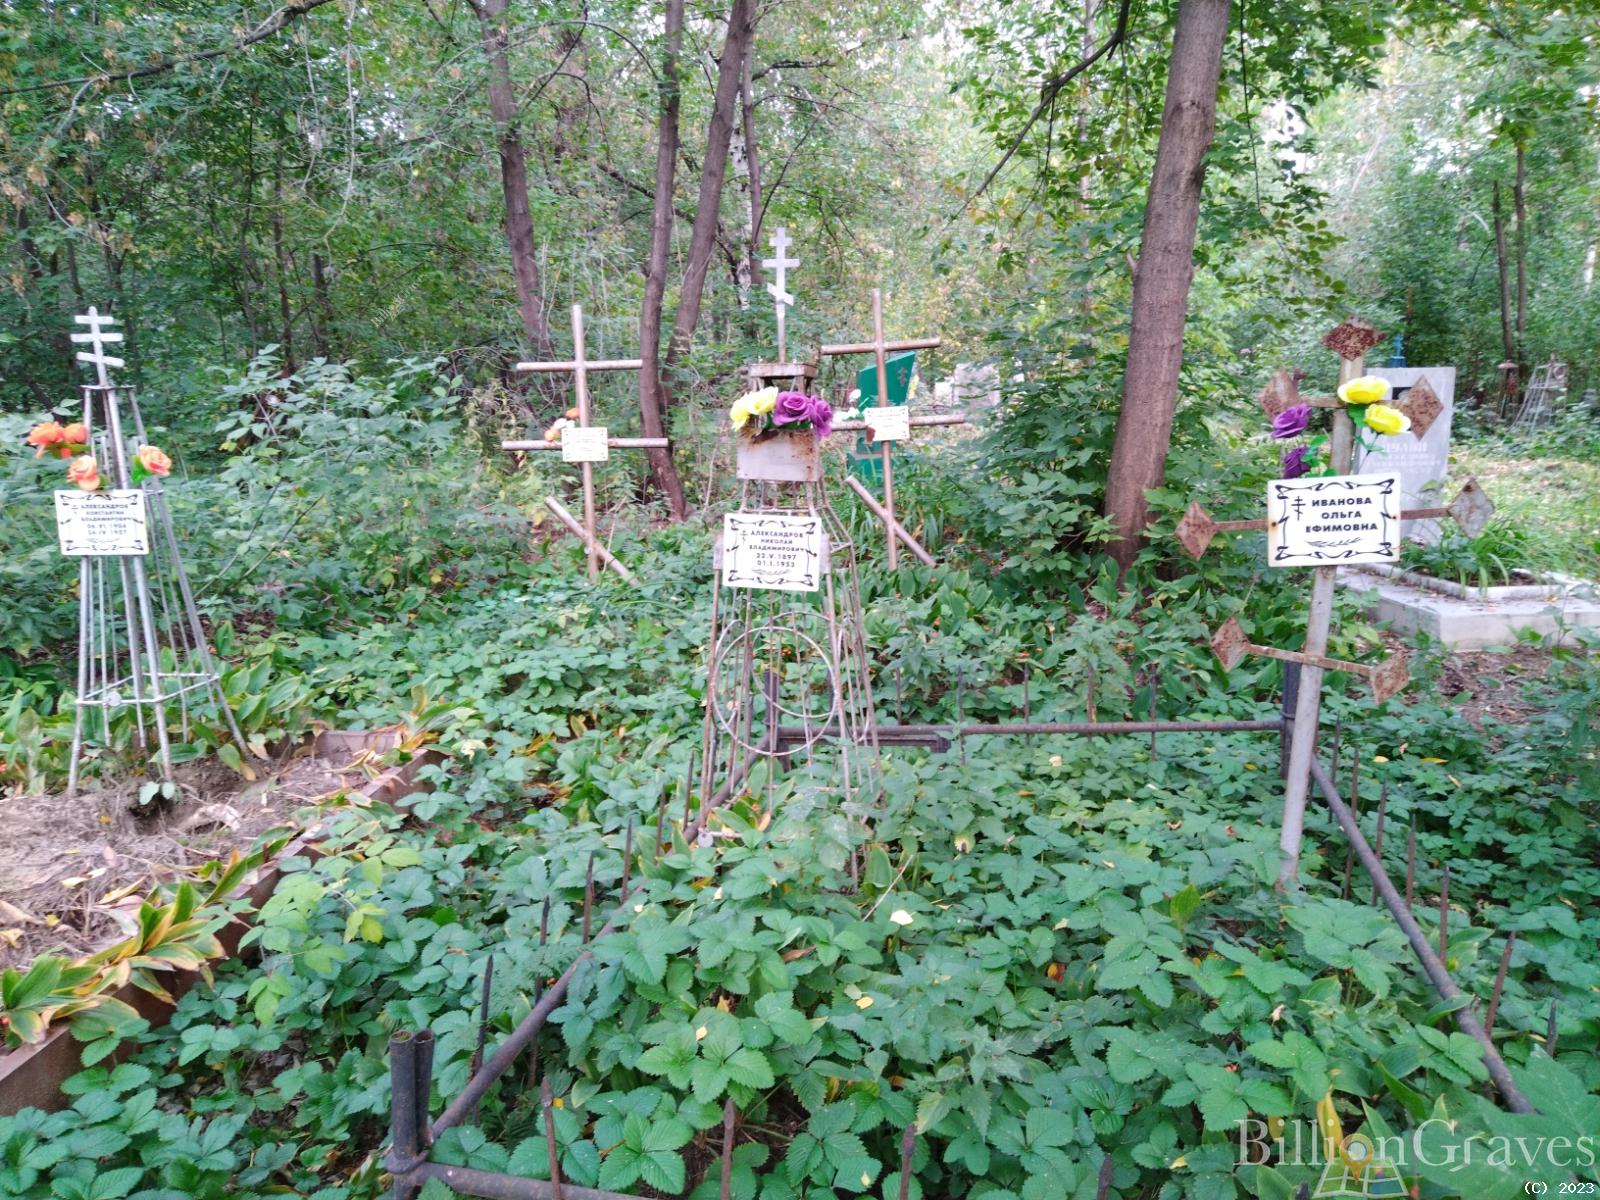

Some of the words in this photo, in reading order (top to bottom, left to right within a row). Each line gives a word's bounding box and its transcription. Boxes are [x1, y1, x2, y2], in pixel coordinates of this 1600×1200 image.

[1311, 497, 1373, 507] ИВАНОВА
[1321, 511, 1362, 520] ОЛЬГА
[1305, 522, 1378, 533] ЕФИМОВНА
[750, 530, 804, 538] АЛЕКСАНДРОВ
[749, 544, 805, 552] ВЛАДИМИРОВИЧ
